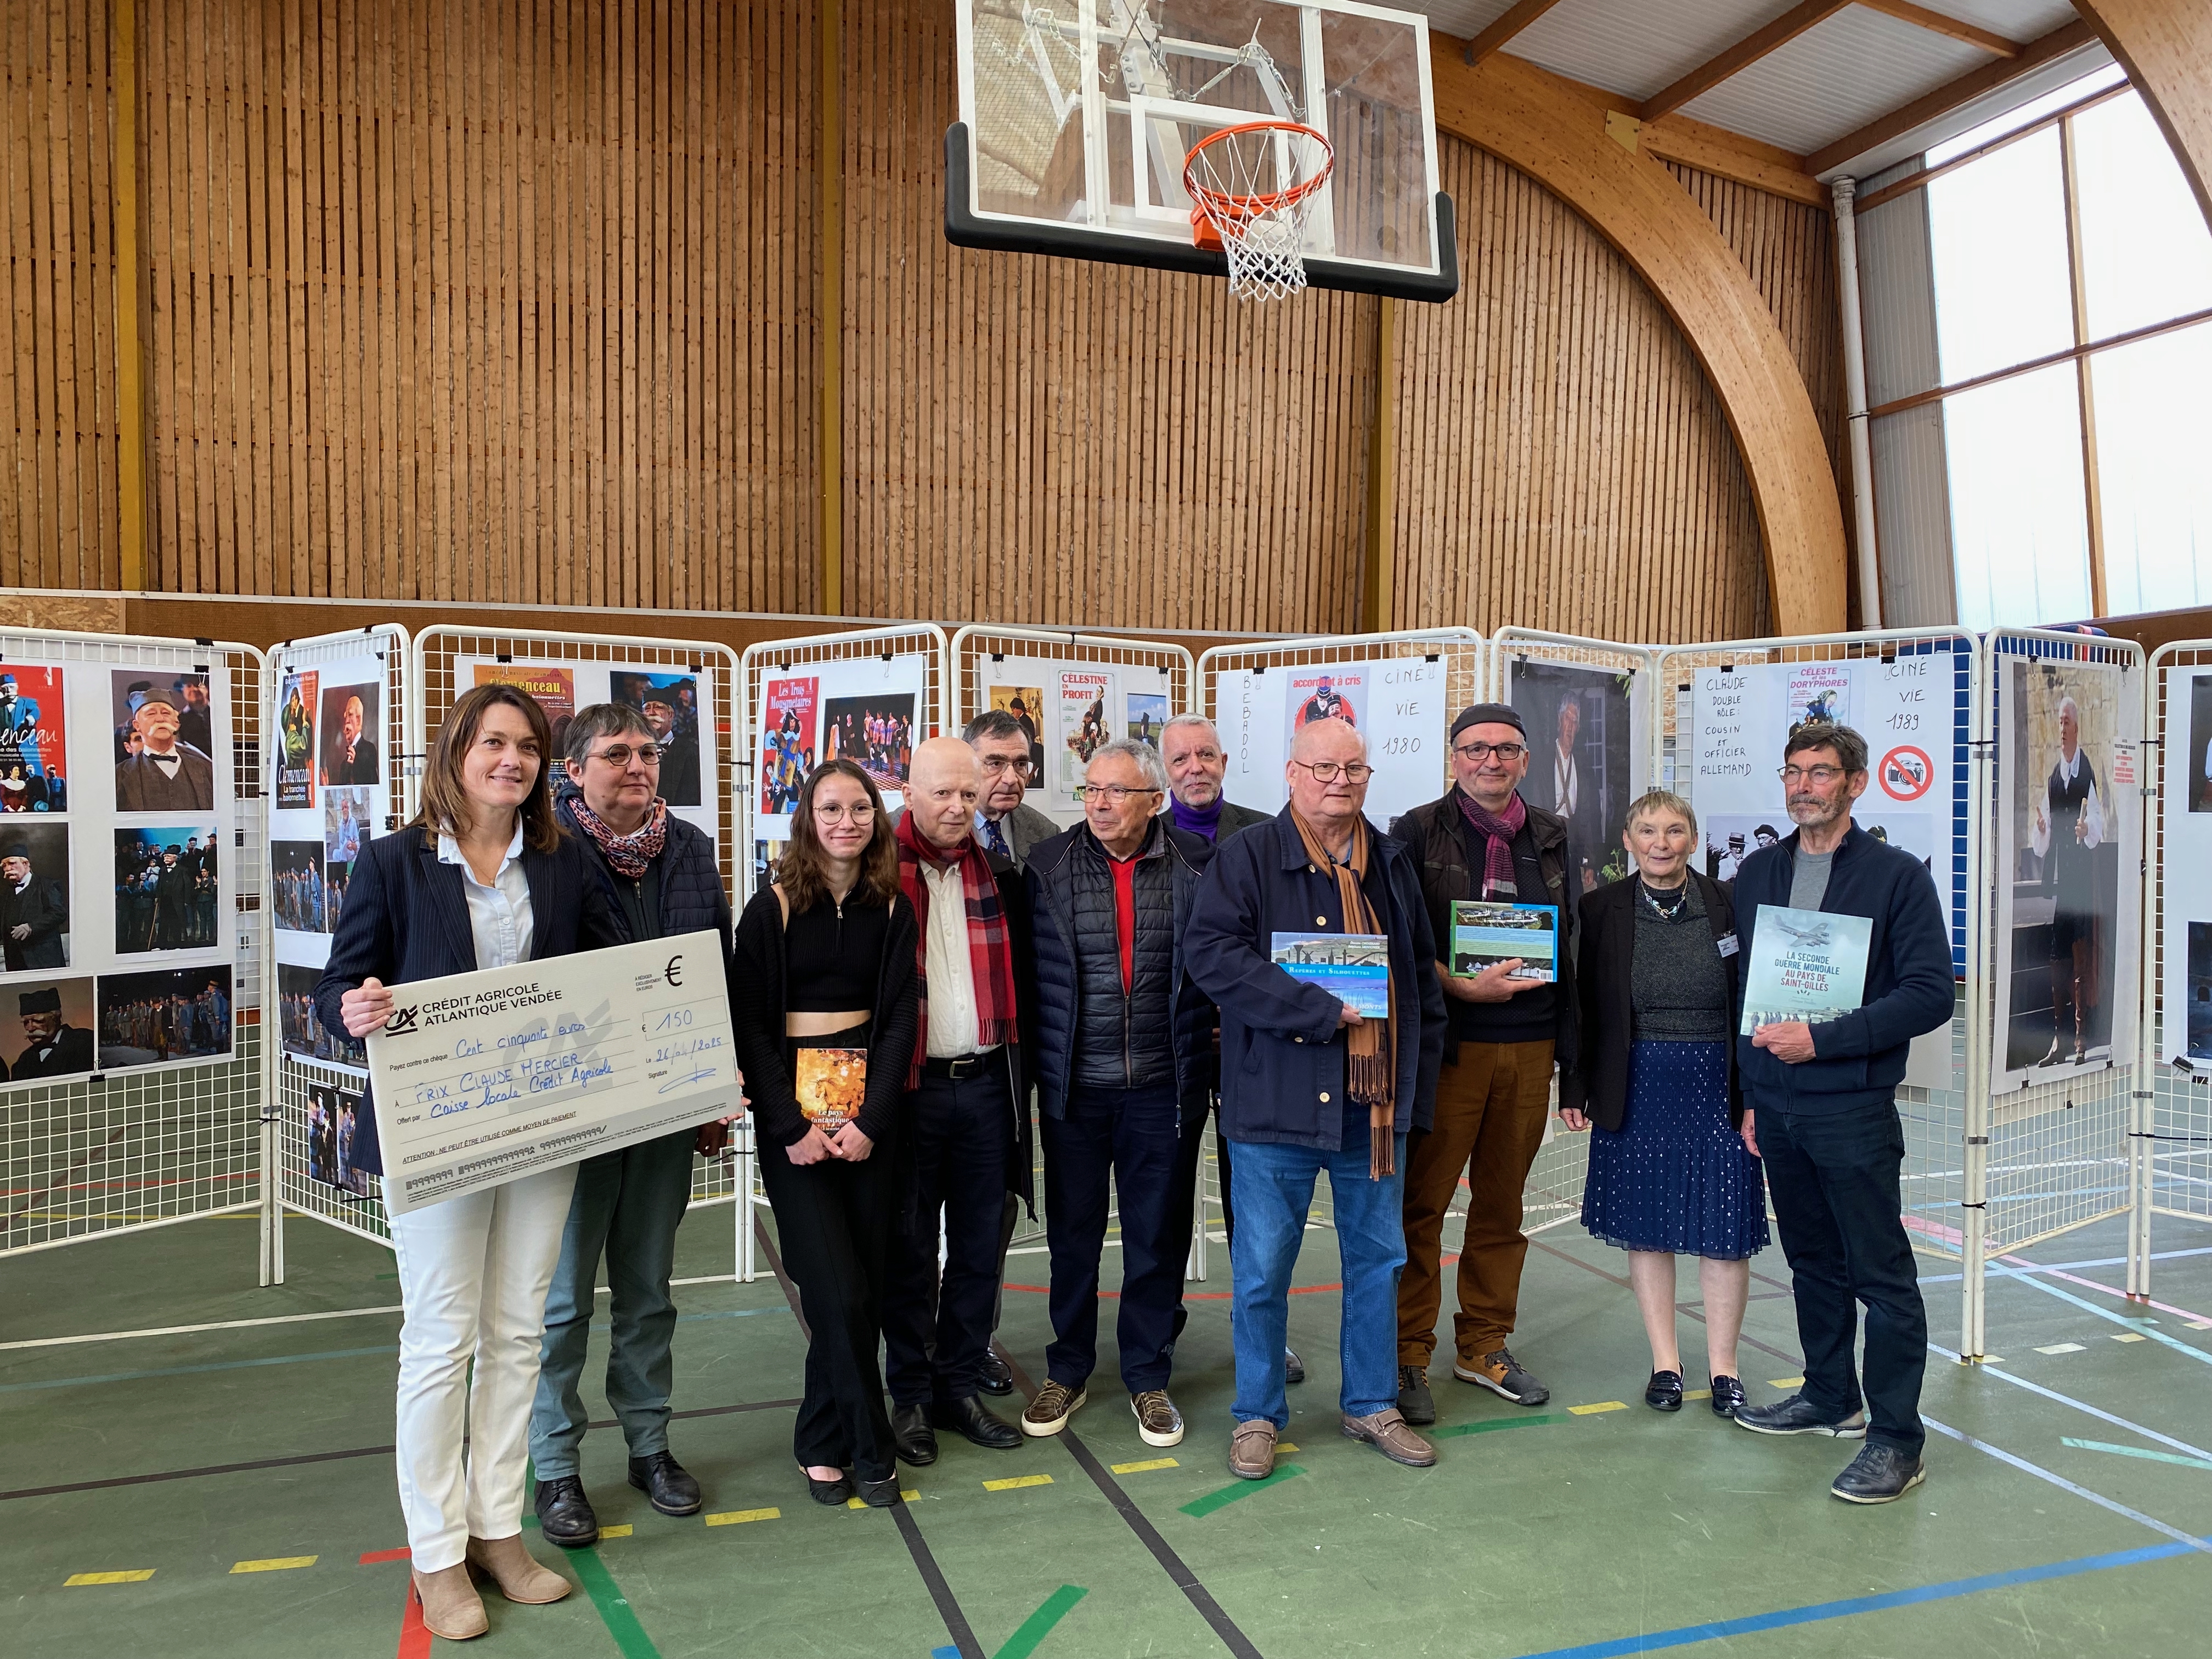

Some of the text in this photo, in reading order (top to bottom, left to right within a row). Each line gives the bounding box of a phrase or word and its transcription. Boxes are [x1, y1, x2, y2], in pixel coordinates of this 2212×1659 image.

[1801, 667, 1838, 676] CÉLESTE
[1062, 673, 1108, 685] CÉLESTINE
[1293, 674, 1361, 688] accords et à cris
[1707, 677, 1747, 691] CLAUDE
[1790, 679, 1848, 689] DORYPHORES
[778, 682, 805, 697] Les Trois
[1062, 690, 1093, 699] PROFIT
[770, 696, 811, 712] Mousquetaires
[1713, 696, 1741, 706] DOUBLE
[1886, 713, 1919, 730] 1989
[1706, 723, 1741, 735] COUSIN
[0, 728, 57, 746] enceau
[1383, 737, 1421, 755] 1980
[1705, 746, 1746, 758] OFFICIER
[279, 761, 311, 784] Clemenceau
[1701, 763, 1751, 777] ALLEMAND
[1787, 951, 1831, 964] LA SECONDE
[664, 955, 682, 986] €
[1774, 958, 1840, 975] GUERRE MONDIALE
[636, 978, 662, 986] EXCLUSIVEMENT
[1785, 969, 1827, 983] AU PAYS DE
[1780, 978, 1829, 992] SAINT-GILLES
[422, 983, 539, 1014] CRÉDIT AGRICOLE
[425, 990, 562, 1026] ATLANTIQUE VENDÉE
[656, 1009, 692, 1031] 150
[642, 1024, 646, 1032] €
[456, 1038, 484, 1058] Cent
[559, 1023, 586, 1035] euros
[390, 1063, 406, 1072] Payez
[407, 1059, 422, 1068] contre
[430, 1053, 448, 1063] chèque
[415, 1053, 583, 1104] PRIX CLAUDE MERCIER
[648, 1070, 668, 1079] Signature
[430, 1058, 613, 1119] Caisse locale Crédit Agricole
[397, 1116, 411, 1125] Offert
[811, 1116, 850, 1125] fantastique
[403, 1150, 435, 1164] ATTENTION
[448, 1142, 464, 1151] PEUT
[464, 1137, 479, 1148] ÊTRE
[480, 1131, 500, 1143] UTILISÉ
[501, 1126, 522, 1137] COMME
[523, 1121, 543, 1131] MOYEN
[551, 1111, 577, 1124] PAIEMENT
